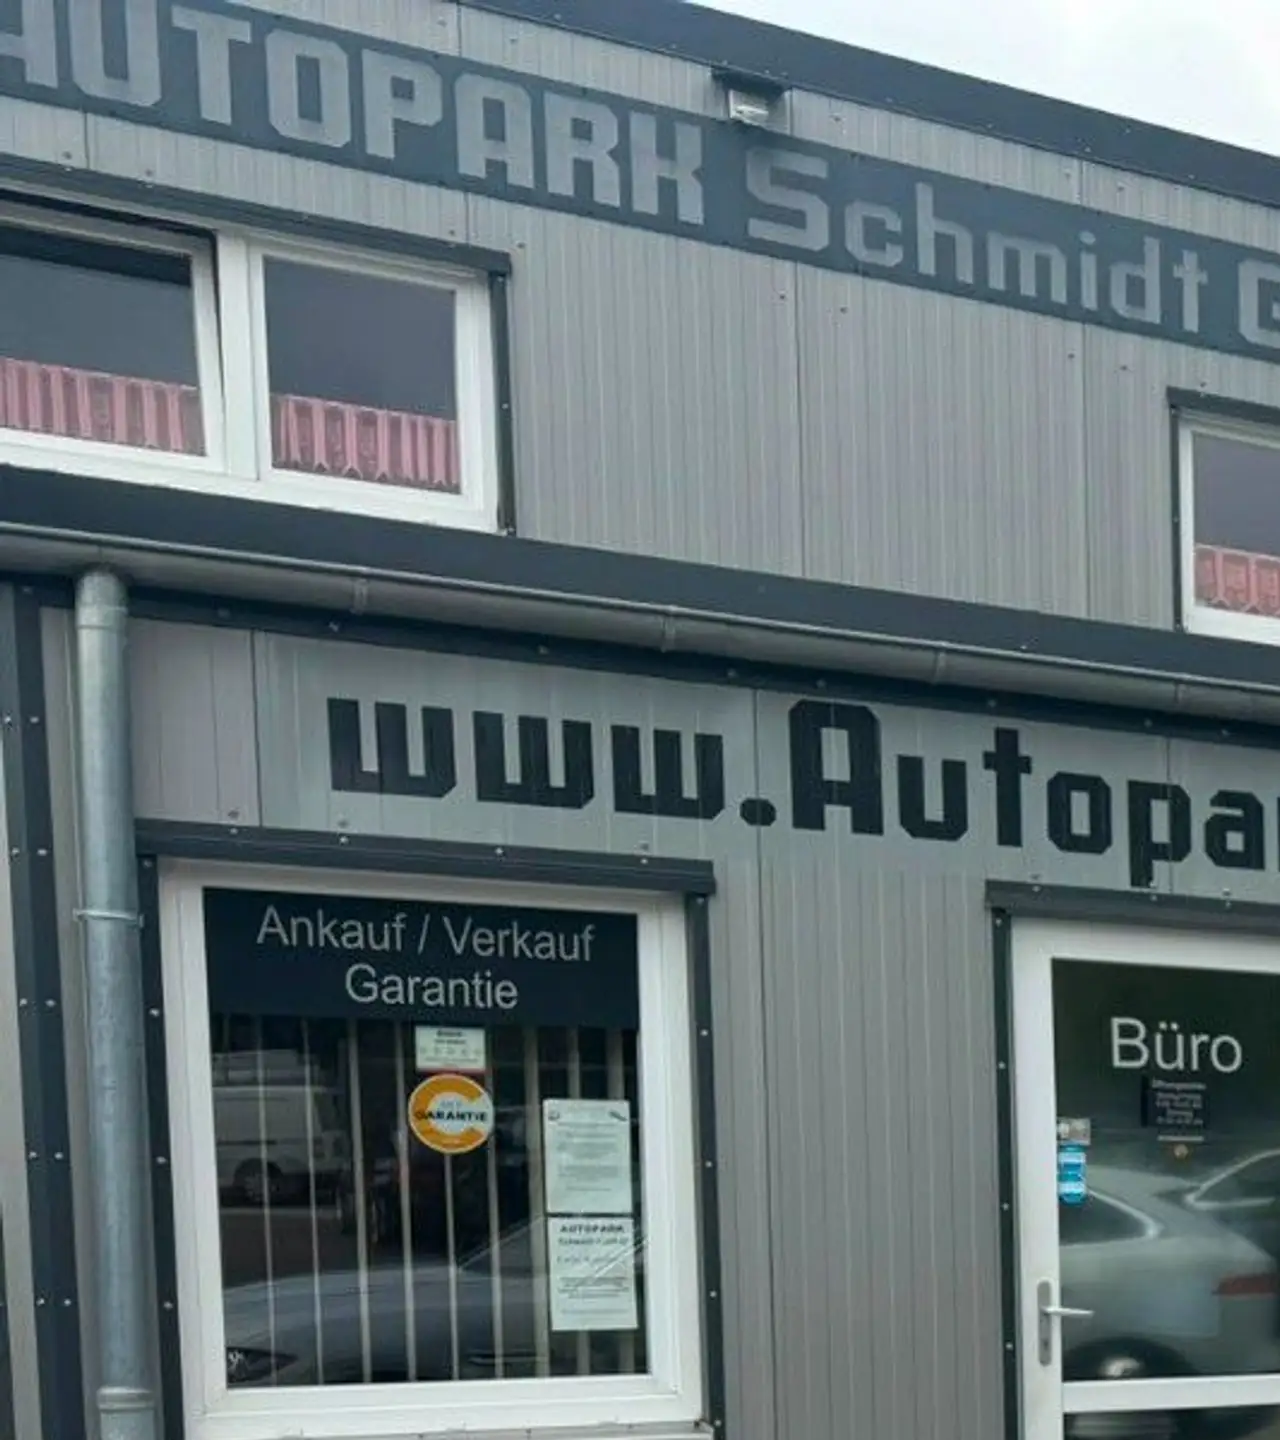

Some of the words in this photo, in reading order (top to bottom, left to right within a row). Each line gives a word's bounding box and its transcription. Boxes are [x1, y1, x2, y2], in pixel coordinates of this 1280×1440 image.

[744, 146, 1207, 334] Schmidt
[256, 904, 406, 953] Ankauf
[416, 914, 434, 955] /
[442, 915, 596, 963] Verkauf
[344, 963, 519, 1010] Garantie
[1110, 1016, 1243, 1074] Büro
